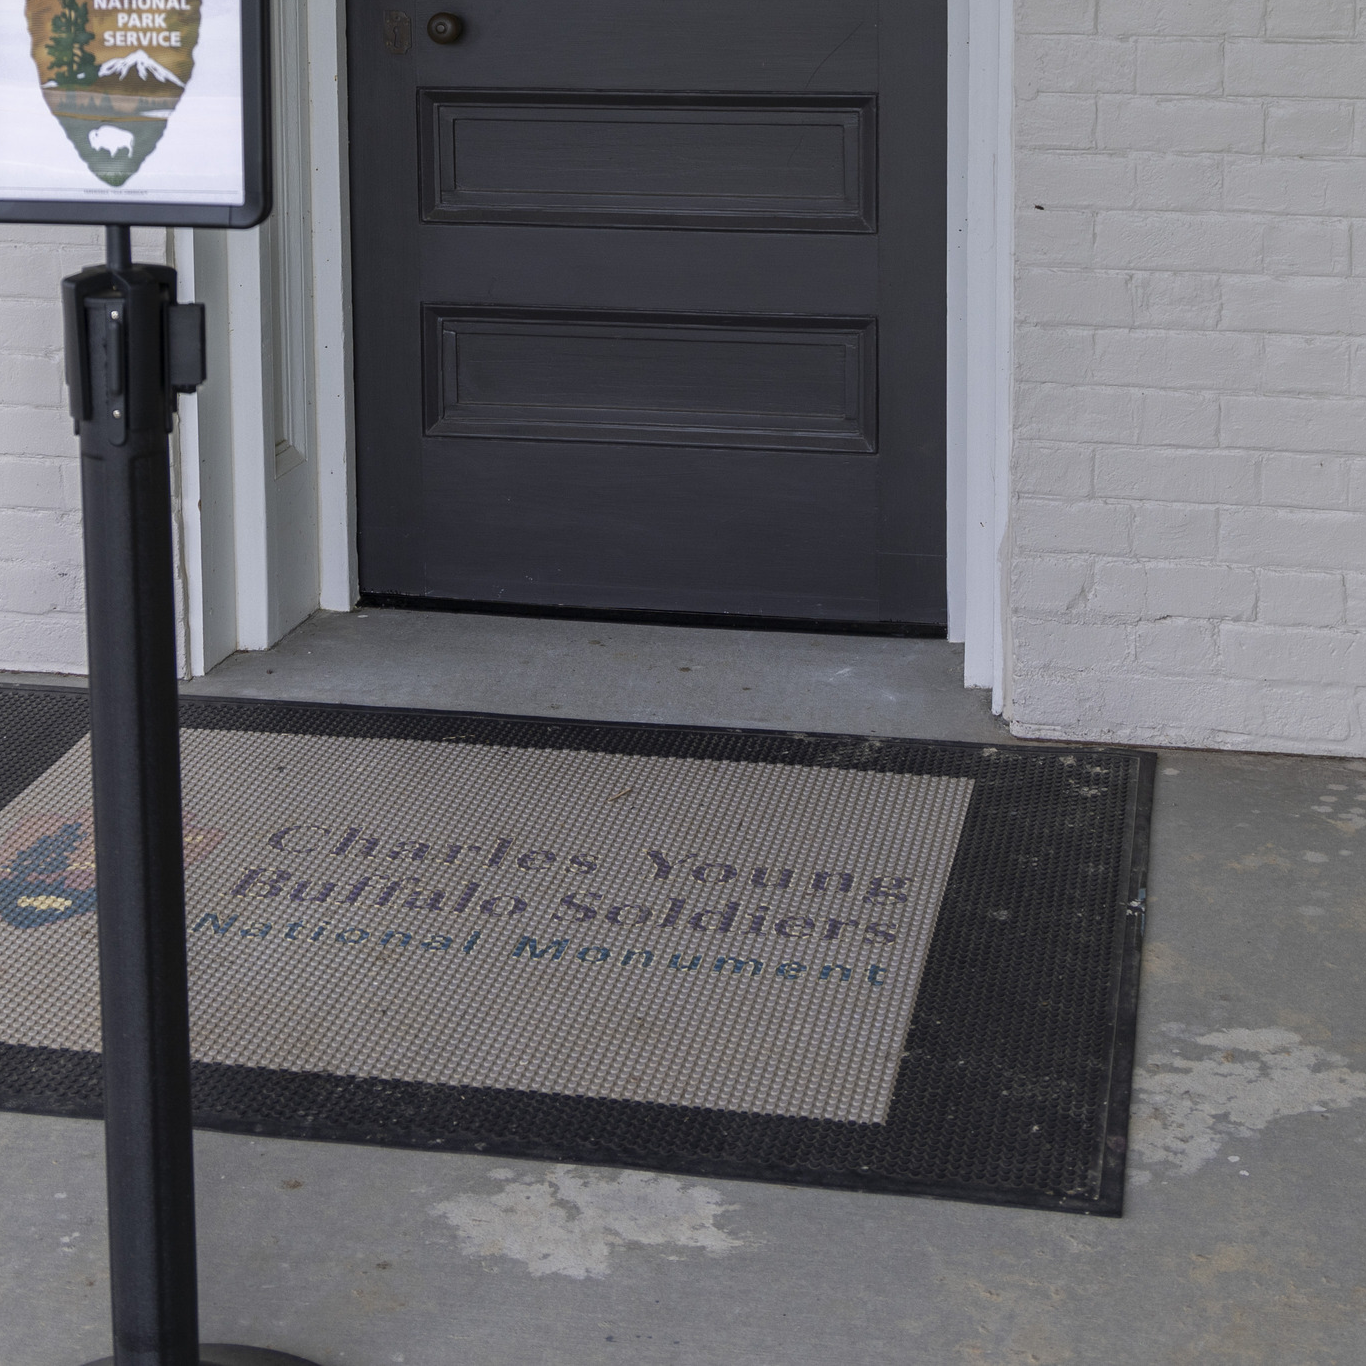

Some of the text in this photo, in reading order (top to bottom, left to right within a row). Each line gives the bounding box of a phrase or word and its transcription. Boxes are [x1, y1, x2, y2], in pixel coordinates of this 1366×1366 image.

[103, 30, 181, 47] SERVICE
[117, 12, 167, 28] PARK
[268, 825, 912, 906] Charles Young
[219, 866, 899, 945] Buffalo Soldiers
[190, 913, 886, 985] National Monument
